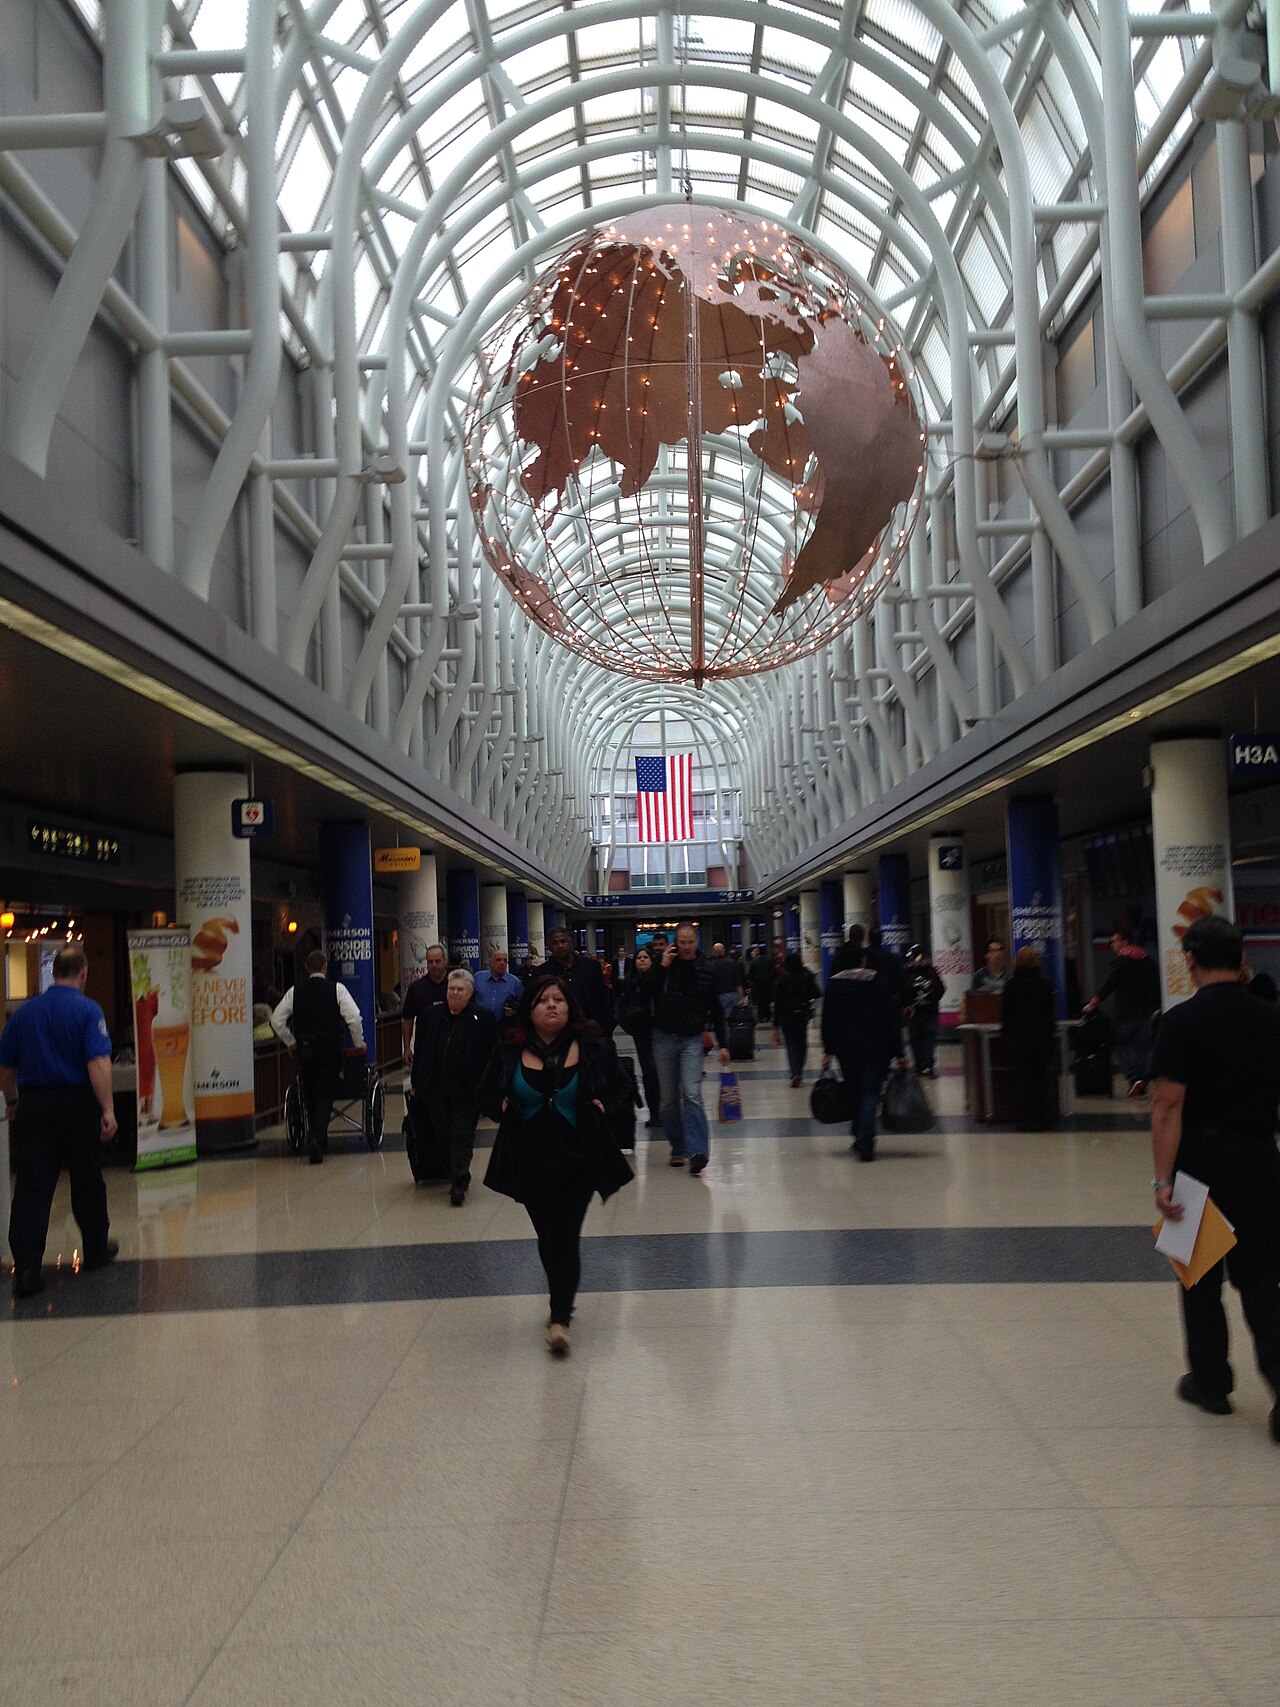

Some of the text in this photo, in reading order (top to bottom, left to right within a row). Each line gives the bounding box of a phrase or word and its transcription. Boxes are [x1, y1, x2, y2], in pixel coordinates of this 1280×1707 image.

[1235, 746, 1279, 765] H3A
[205, 978, 247, 992] NEVER
[213, 992, 247, 1006] DONE
[192, 1006, 247, 1025] EFORE
